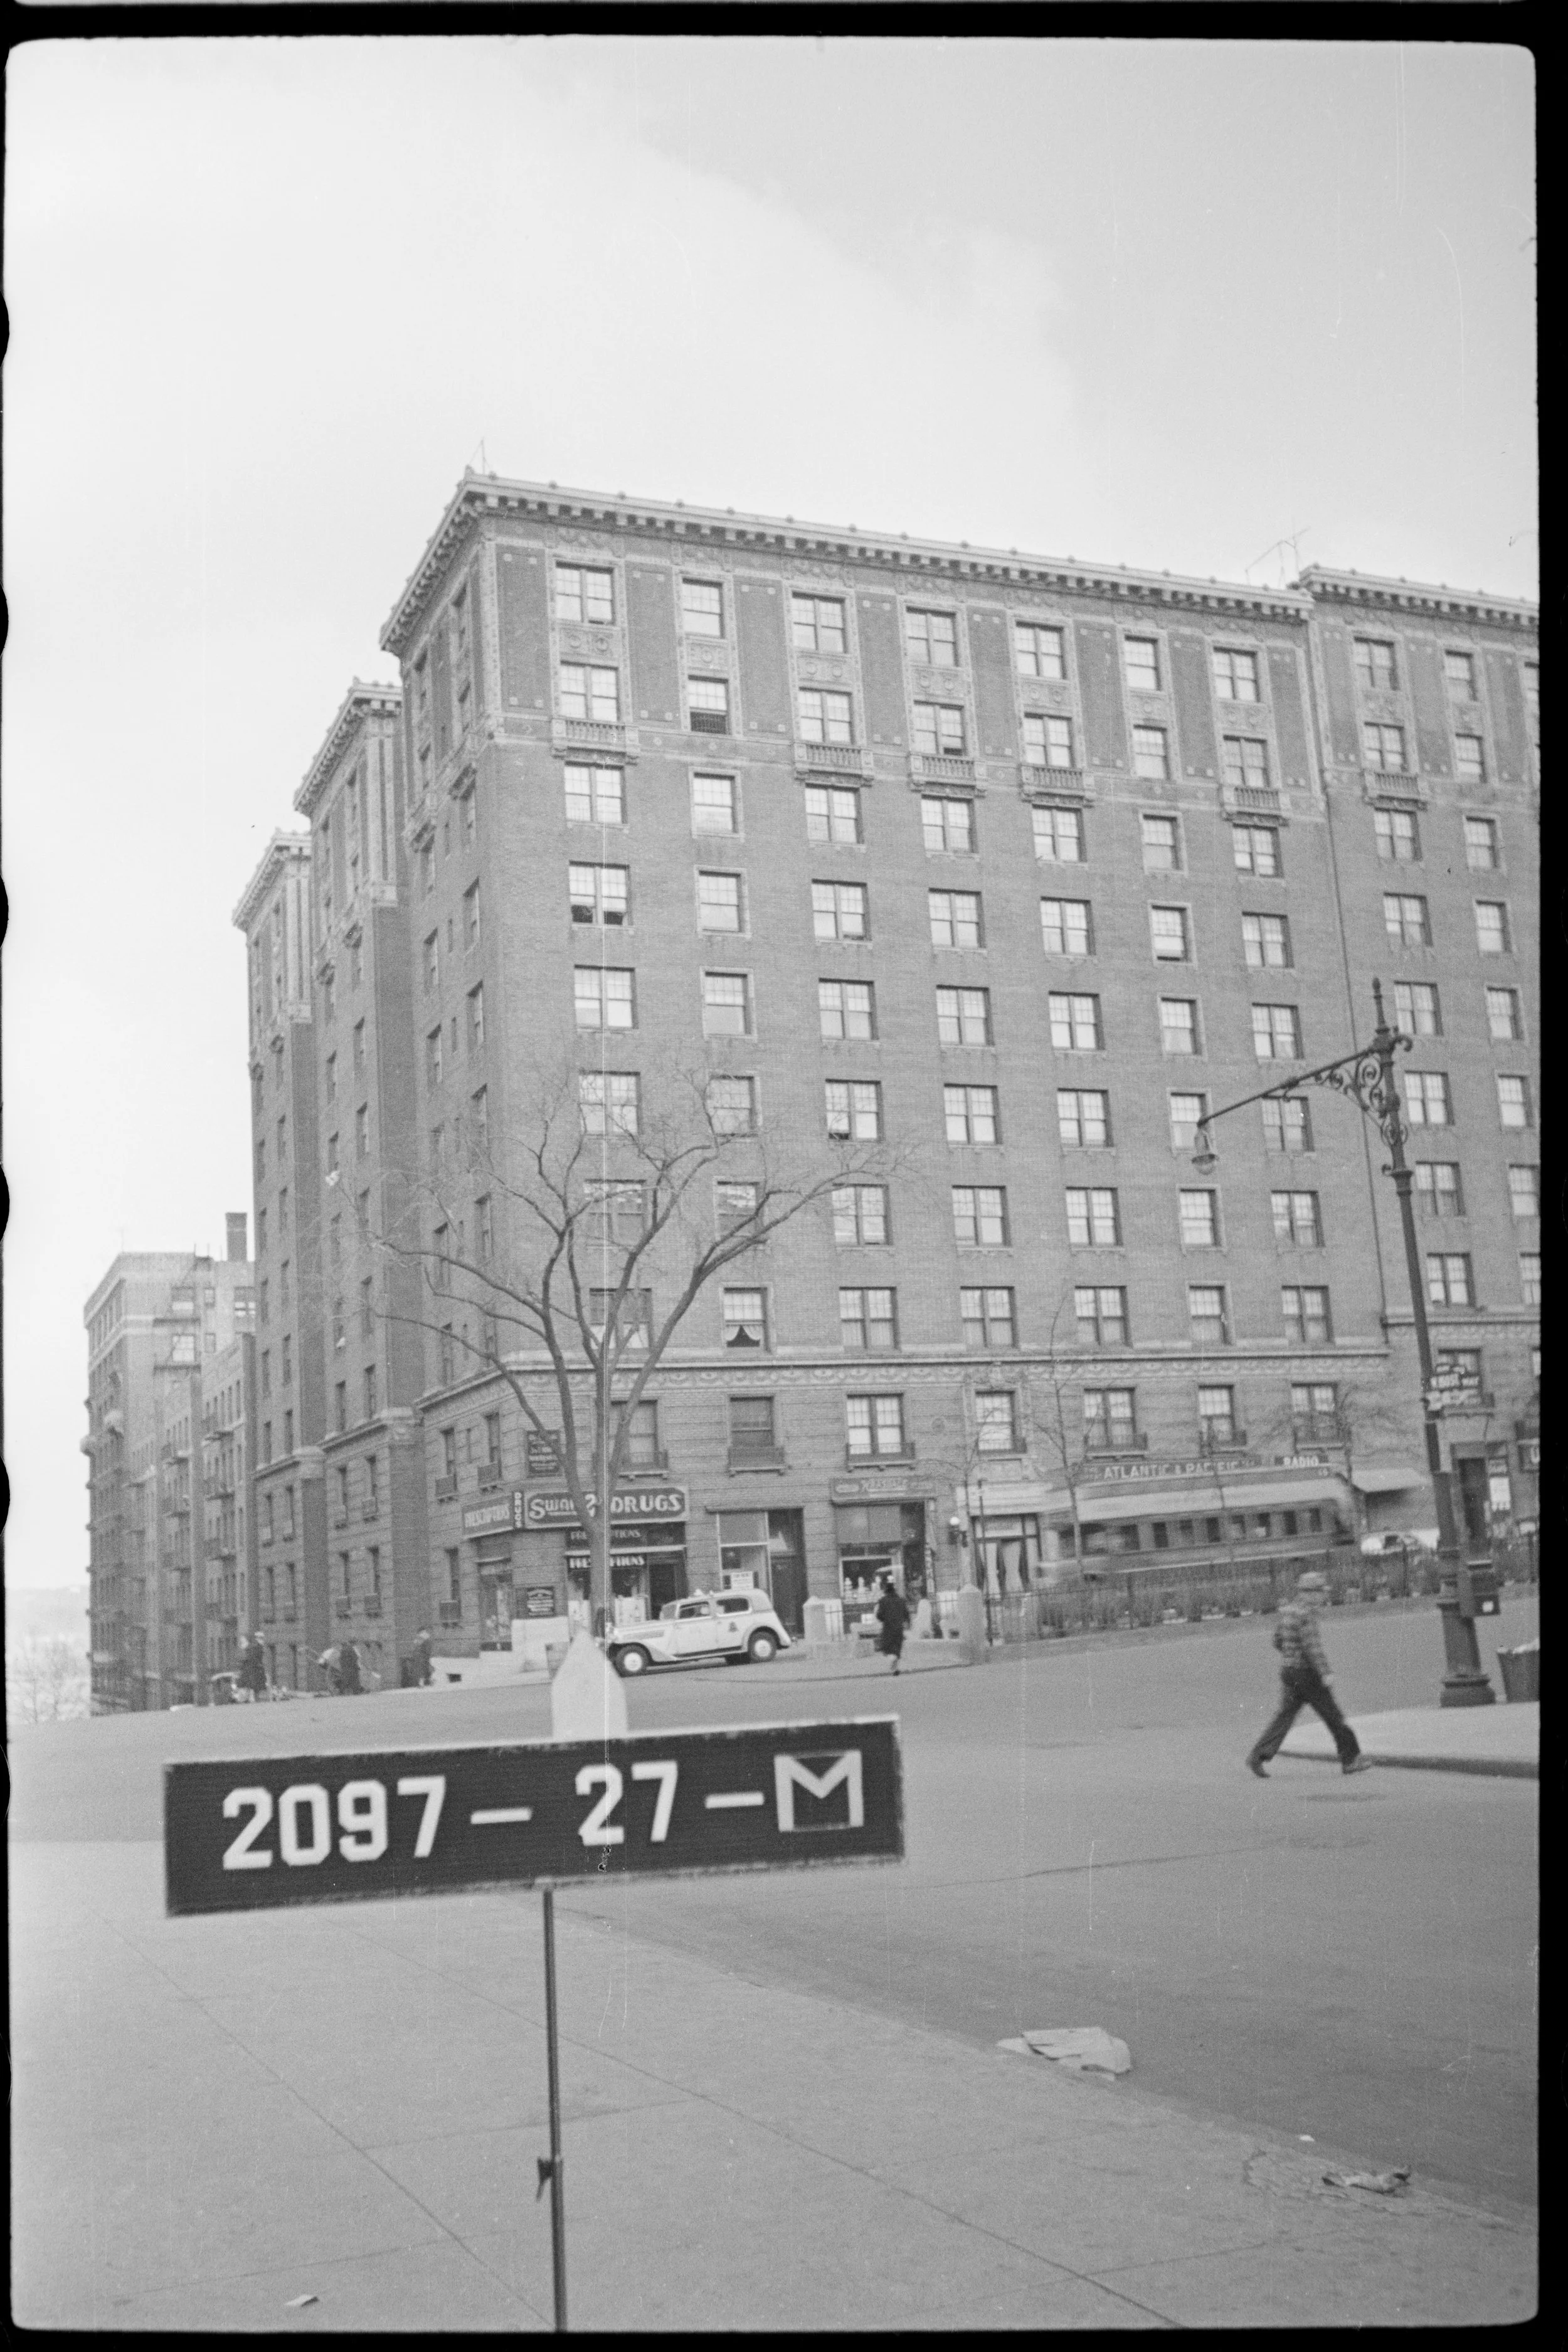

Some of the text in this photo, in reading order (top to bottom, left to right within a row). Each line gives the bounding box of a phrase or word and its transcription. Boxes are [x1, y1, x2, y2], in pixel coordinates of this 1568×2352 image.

[1104, 1464, 1170, 1479] ATLANTIC
[1185, 1461, 1238, 1473] PACFIC
[1283, 1456, 1319, 1468] RADIO
[610, 1493, 682, 1513] DRUGS
[223, 1776, 445, 1870] 2097
[575, 1761, 678, 1846] 27
[774, 1750, 864, 1832] M
